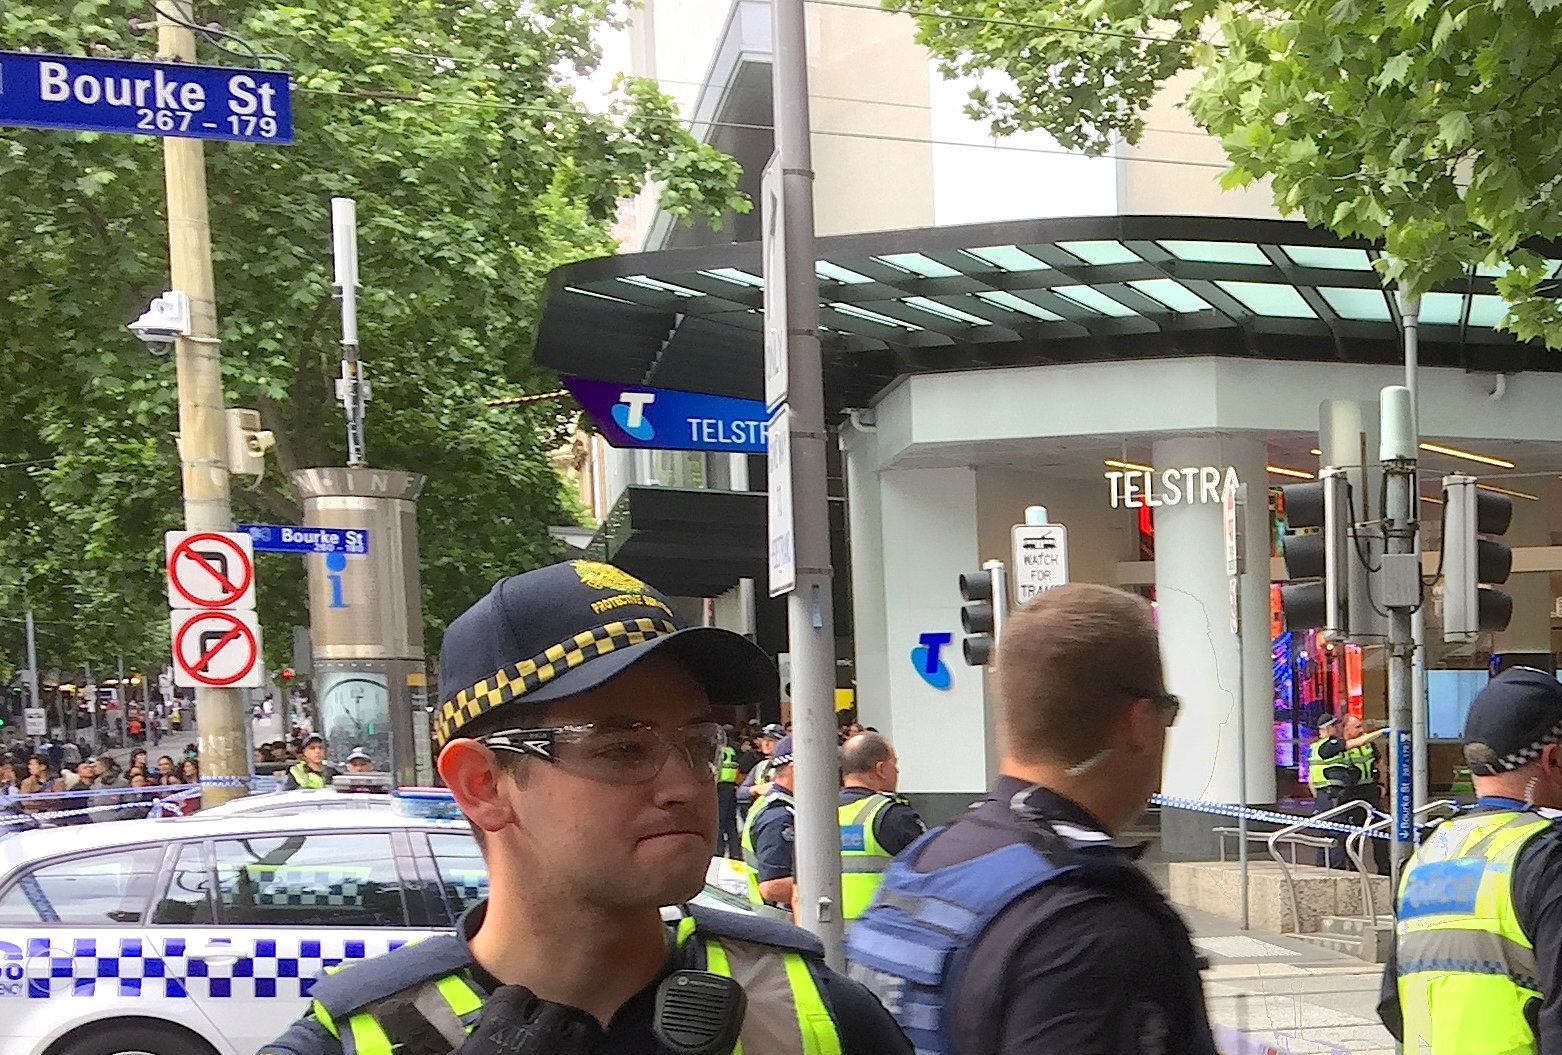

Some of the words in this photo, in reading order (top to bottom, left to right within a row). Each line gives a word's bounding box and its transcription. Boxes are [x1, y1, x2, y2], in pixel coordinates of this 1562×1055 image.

[39, 61, 206, 111] Bourke
[227, 74, 276, 117] St
[136, 108, 192, 132] 267
[227, 115, 277, 138] 179
[1104, 466, 1240, 509] TELSTRA
[281, 528, 340, 544] Bourke
[345, 531, 364, 545] St
[1024, 553, 1059, 566] WATCH
[1031, 570, 1053, 581] FOR
[1400, 795, 1411, 829] Bourke
